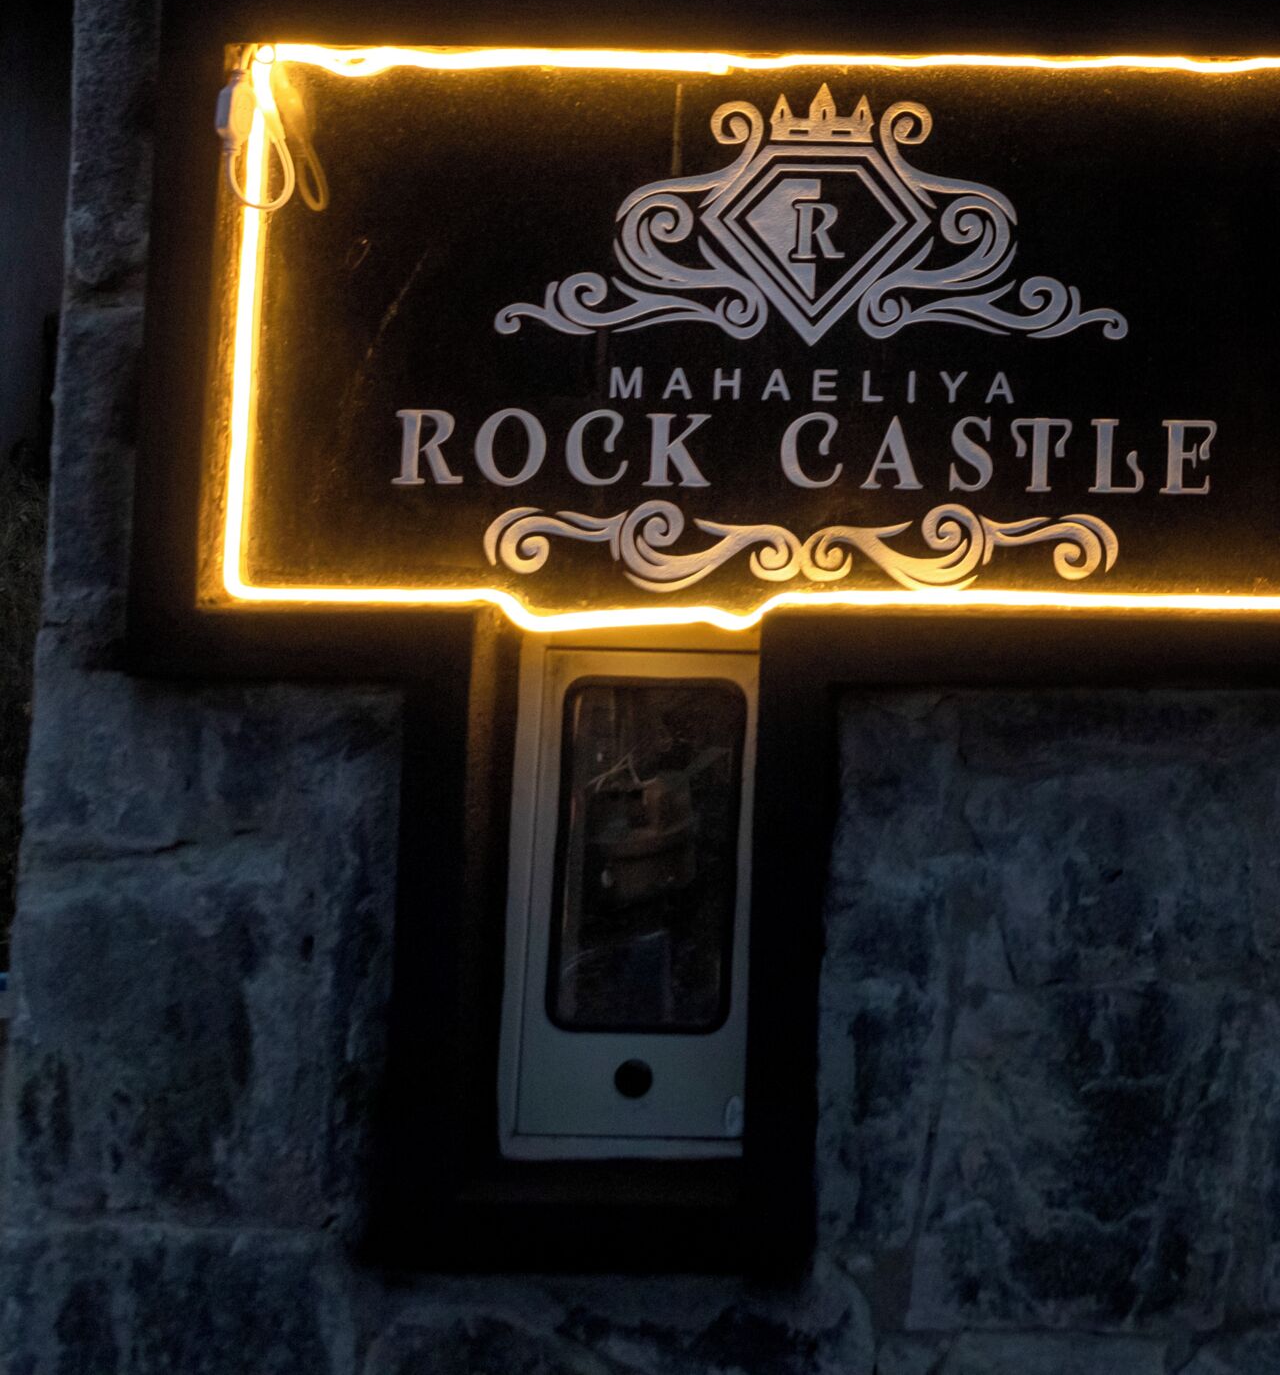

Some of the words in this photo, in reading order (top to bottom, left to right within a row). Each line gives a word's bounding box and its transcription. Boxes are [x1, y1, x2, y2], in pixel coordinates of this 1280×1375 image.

[791, 203, 845, 259] R
[609, 365, 1015, 404] MAHAELIYA
[391, 408, 712, 488] ROCK
[779, 411, 1218, 496] CASTLE
